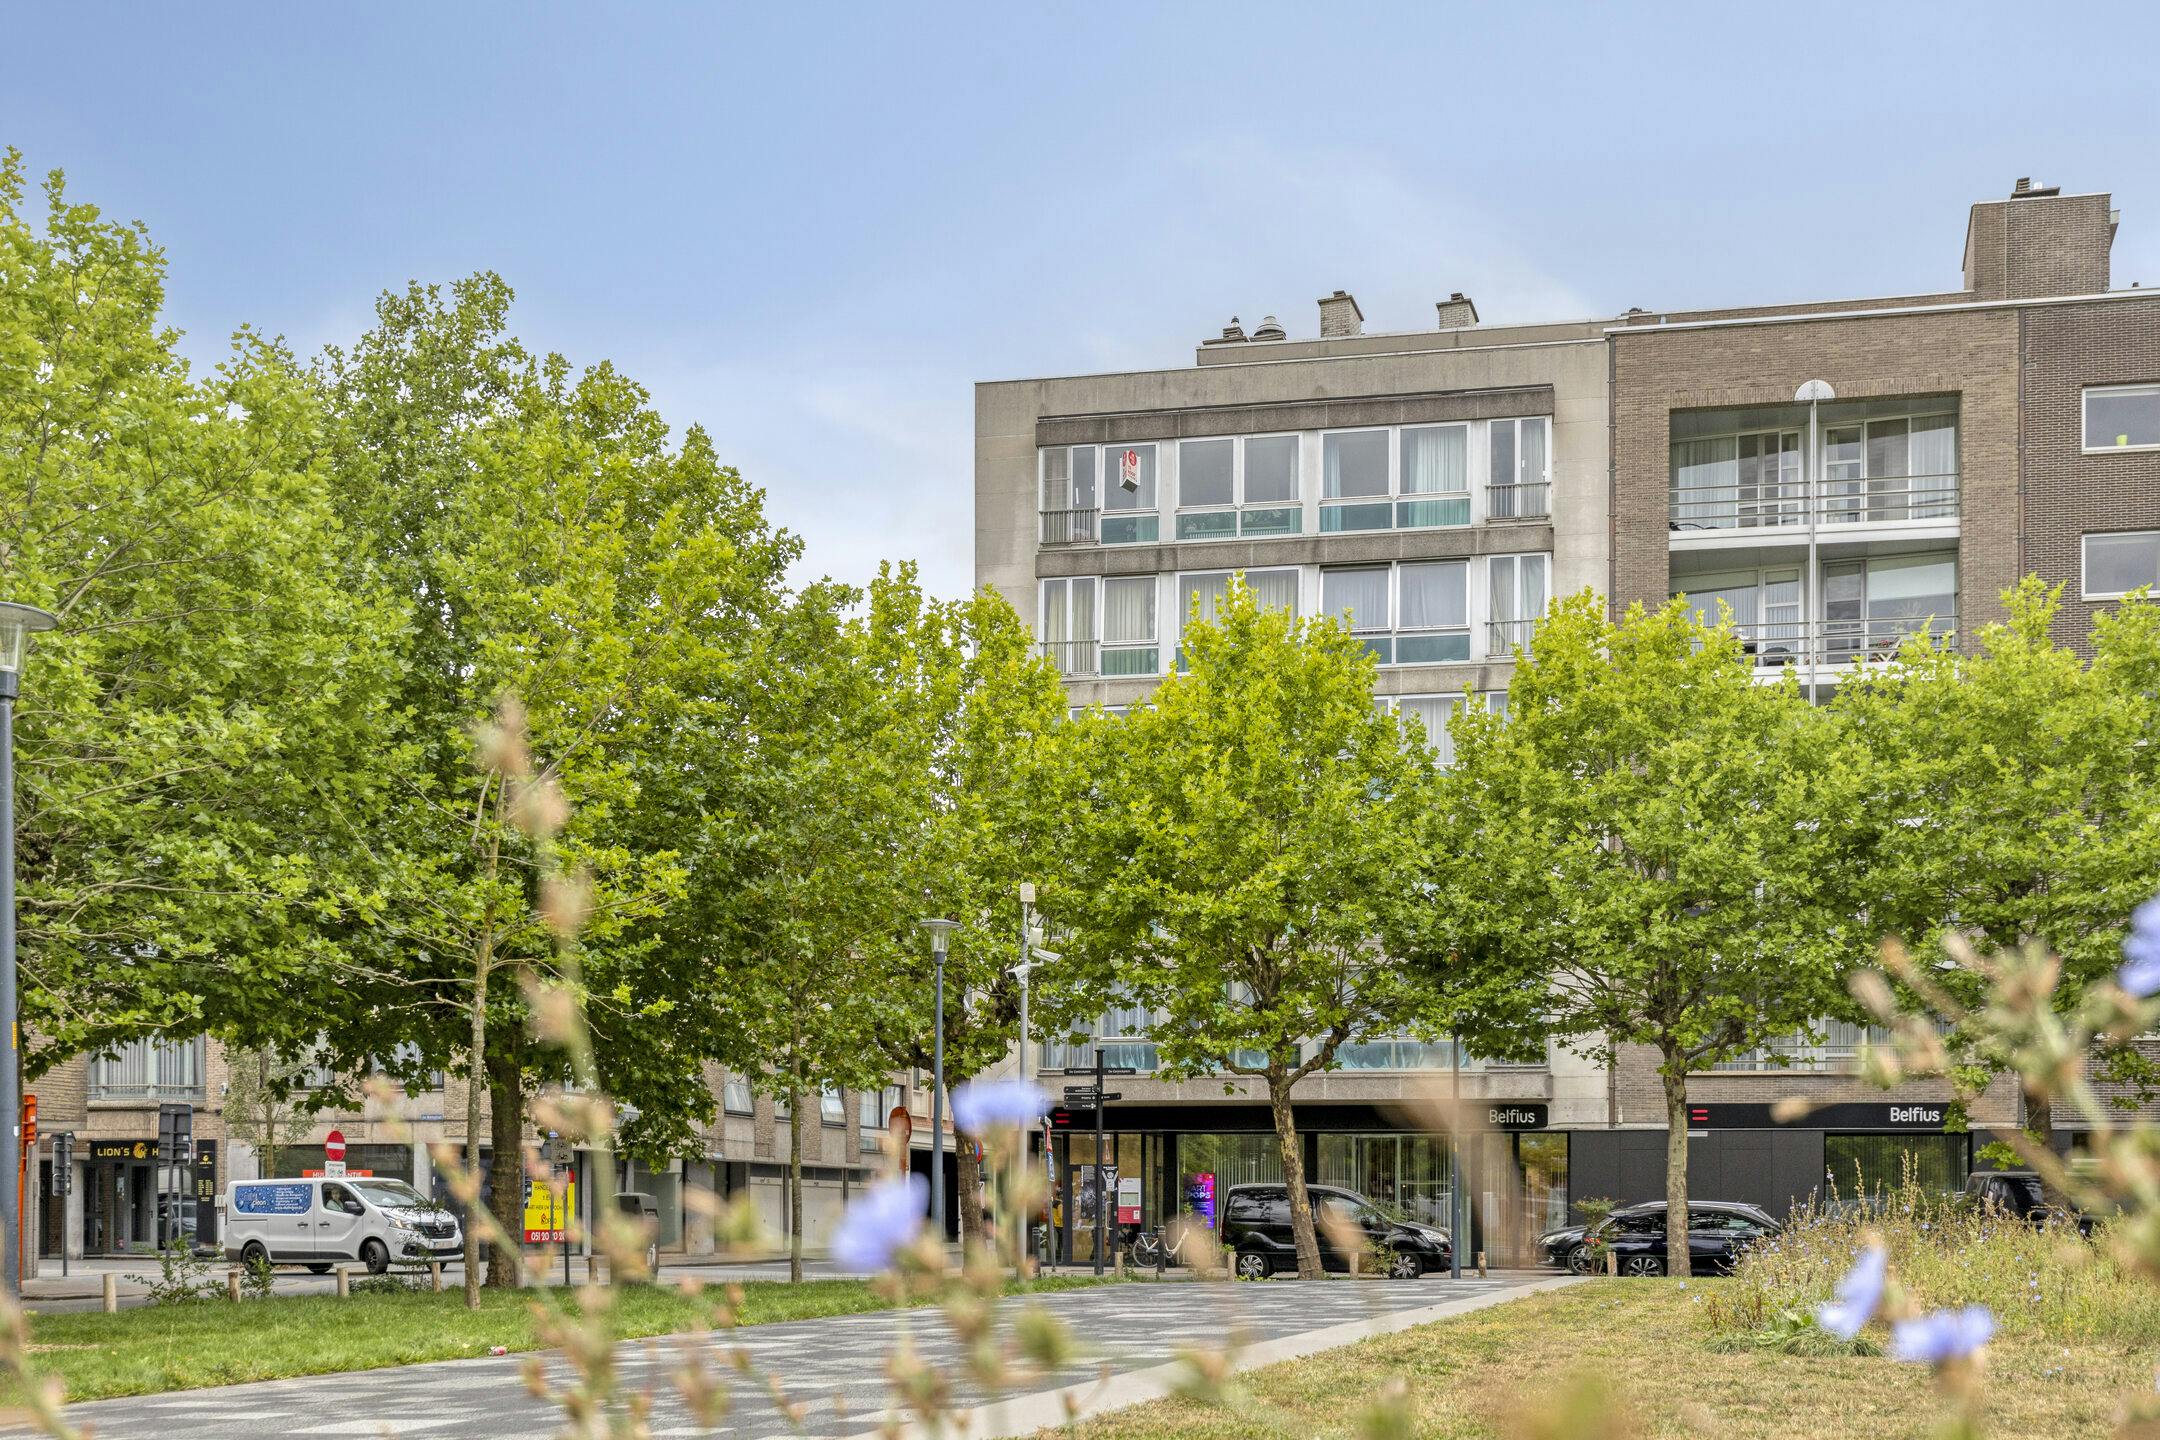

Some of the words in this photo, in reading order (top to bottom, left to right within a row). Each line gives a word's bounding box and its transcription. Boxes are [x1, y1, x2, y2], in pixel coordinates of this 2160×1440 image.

[1489, 1109, 1535, 1123] Belfius
[1890, 1107, 1940, 1122] Belfius
[97, 1147, 130, 1156] LION'S
[541, 1232, 550, 1241] 20
